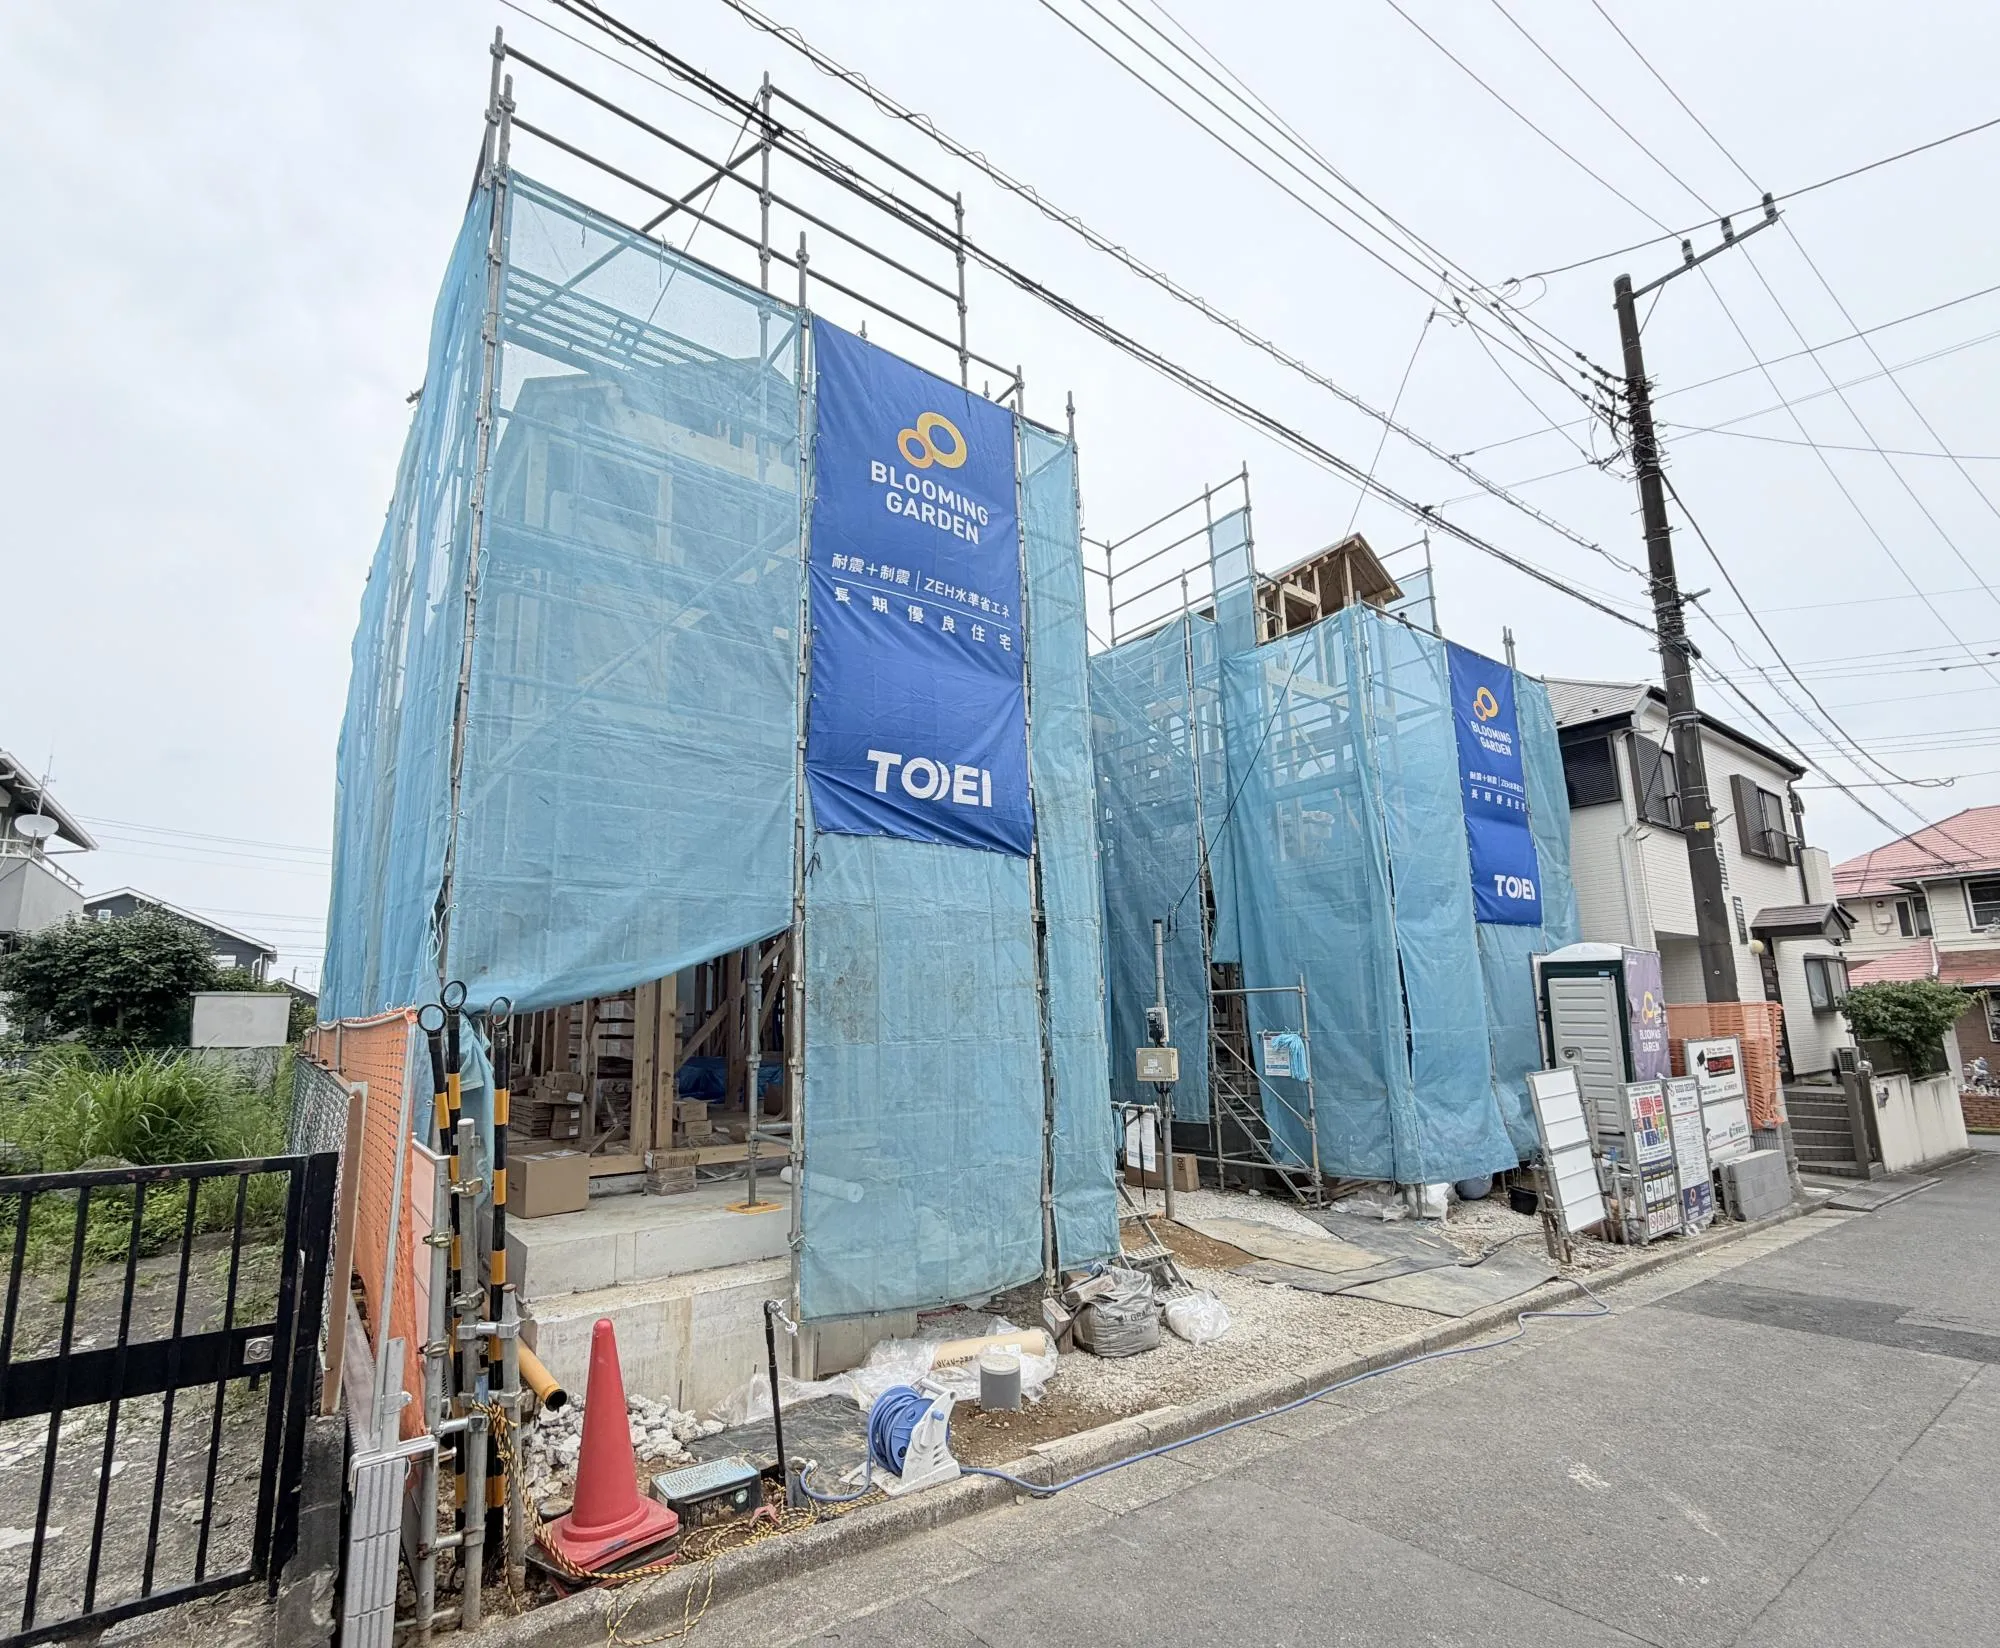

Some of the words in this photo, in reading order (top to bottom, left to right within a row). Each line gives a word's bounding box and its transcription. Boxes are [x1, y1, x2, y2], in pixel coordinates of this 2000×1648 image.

[871, 459, 989, 526] BLOOMING
[885, 491, 979, 545] GARDEN
[834, 586, 1011, 652] 長期優良住宅
[924, 577, 1010, 619] ZEH水準省エネ
[1470, 720, 1512, 744] BLOOMING
[1480, 736, 1512, 757] GARDEN
[867, 749, 992, 808] TOEI
